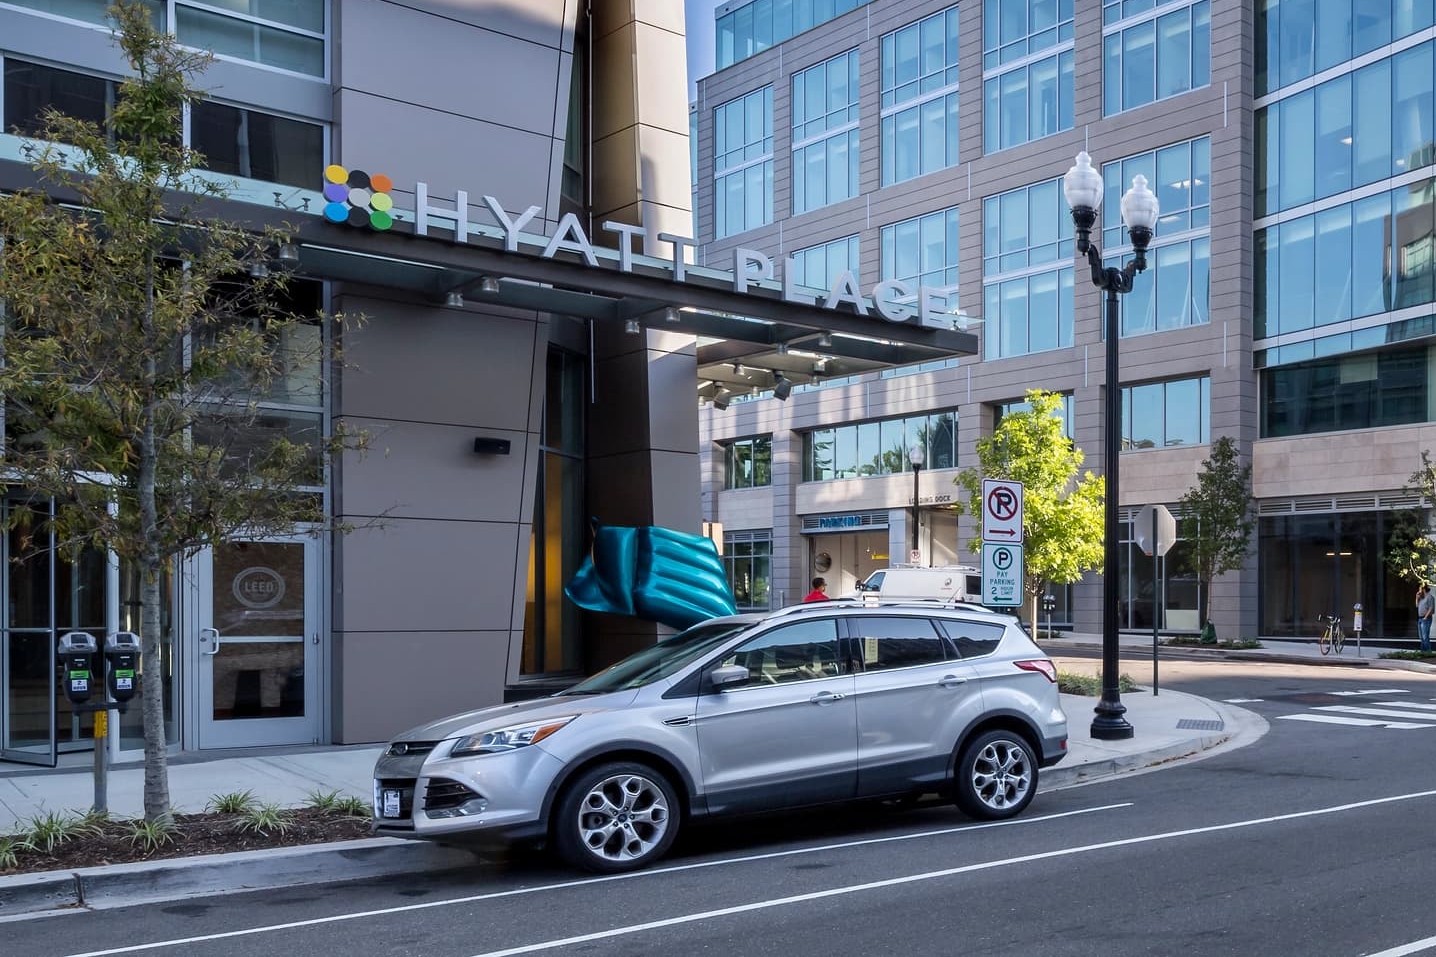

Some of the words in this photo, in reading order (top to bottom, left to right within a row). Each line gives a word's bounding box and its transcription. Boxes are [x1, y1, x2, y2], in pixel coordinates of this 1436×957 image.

[414, 181, 699, 283] HYATT
[732, 246, 952, 332] PLACE
[935, 495, 951, 503] DOCK
[990, 578, 1015, 586] PARKING
[245, 582, 273, 593] LEED
[991, 586, 997, 595] 2
